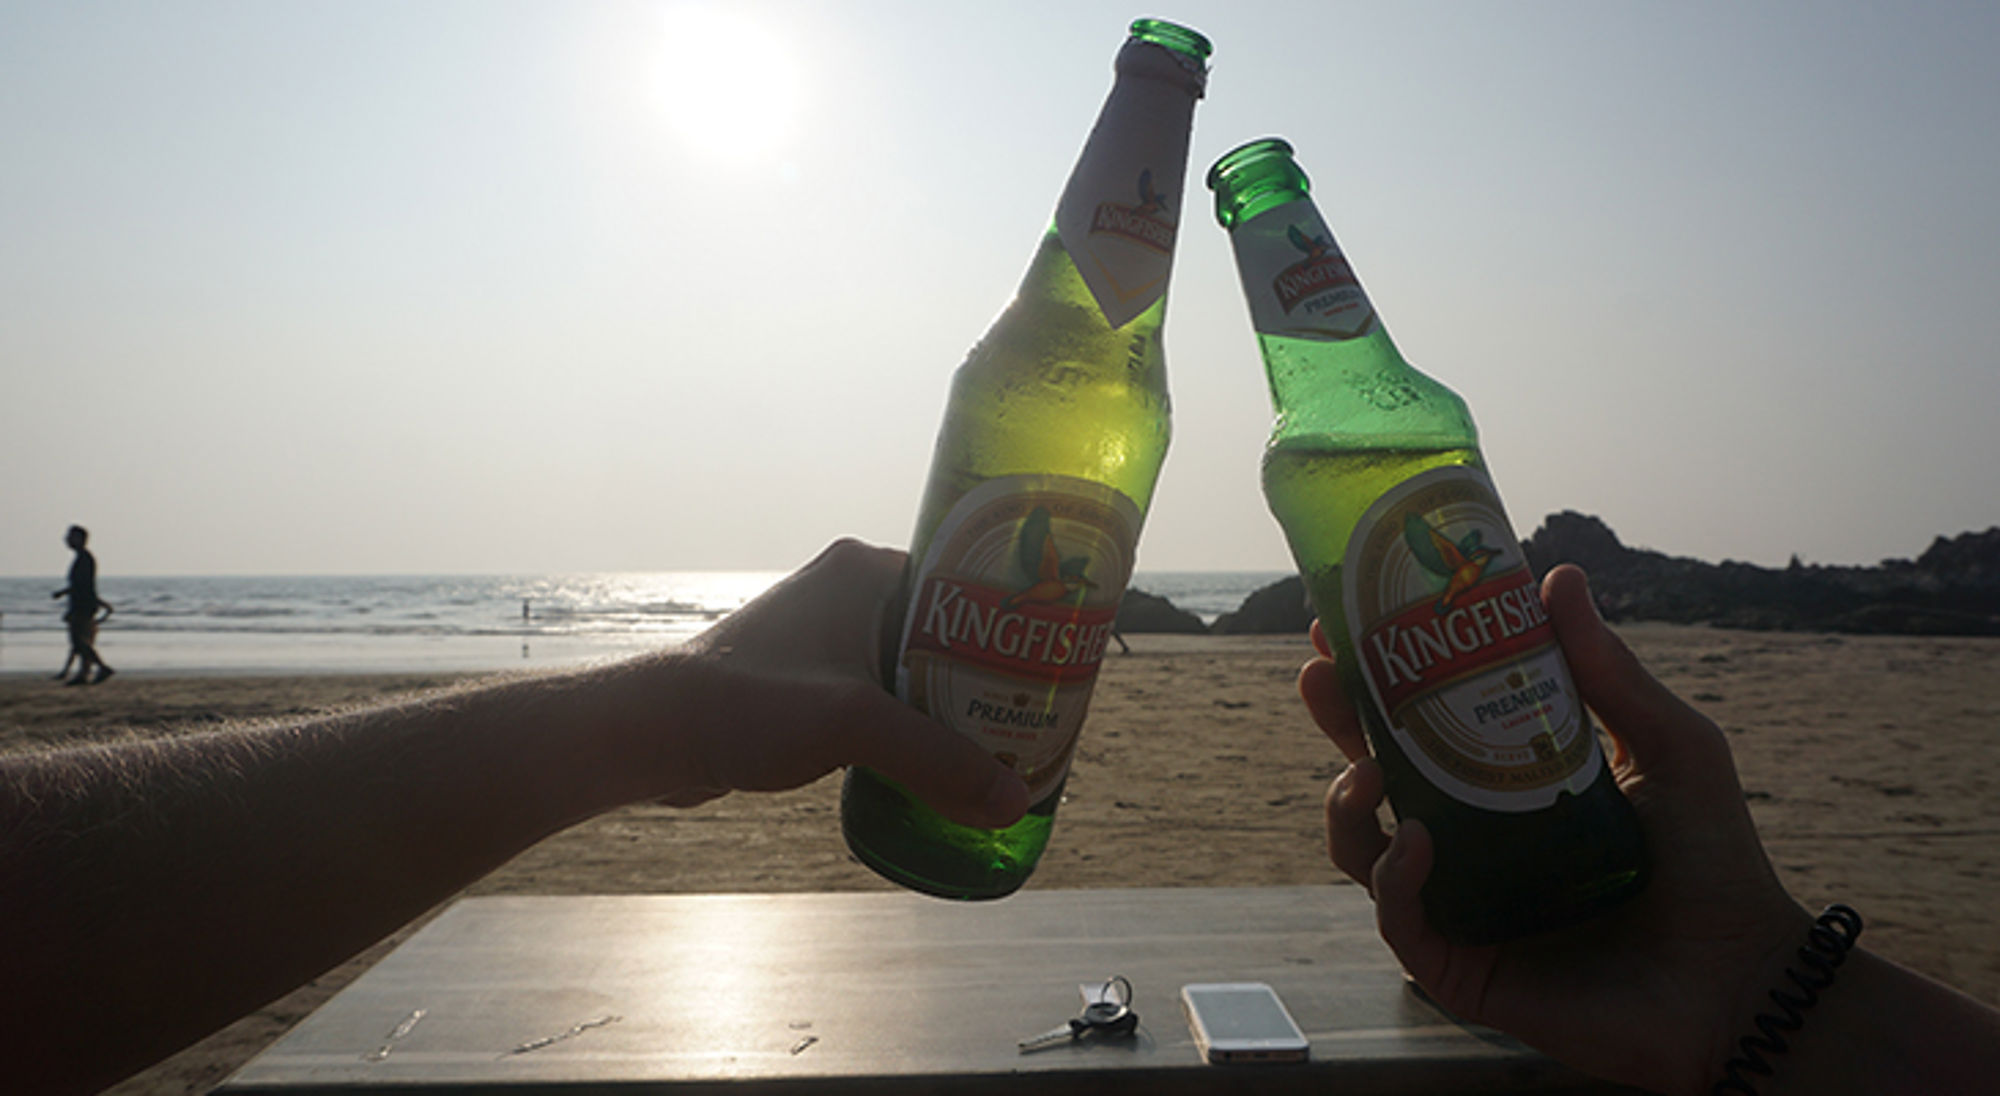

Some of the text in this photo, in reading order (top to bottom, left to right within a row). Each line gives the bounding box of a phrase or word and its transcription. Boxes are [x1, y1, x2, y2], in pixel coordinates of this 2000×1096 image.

[1372, 581, 1550, 687] KINGFISHE
[967, 698, 1058, 728] PREMIUM
[1473, 677, 1560, 724] PREMIUM
